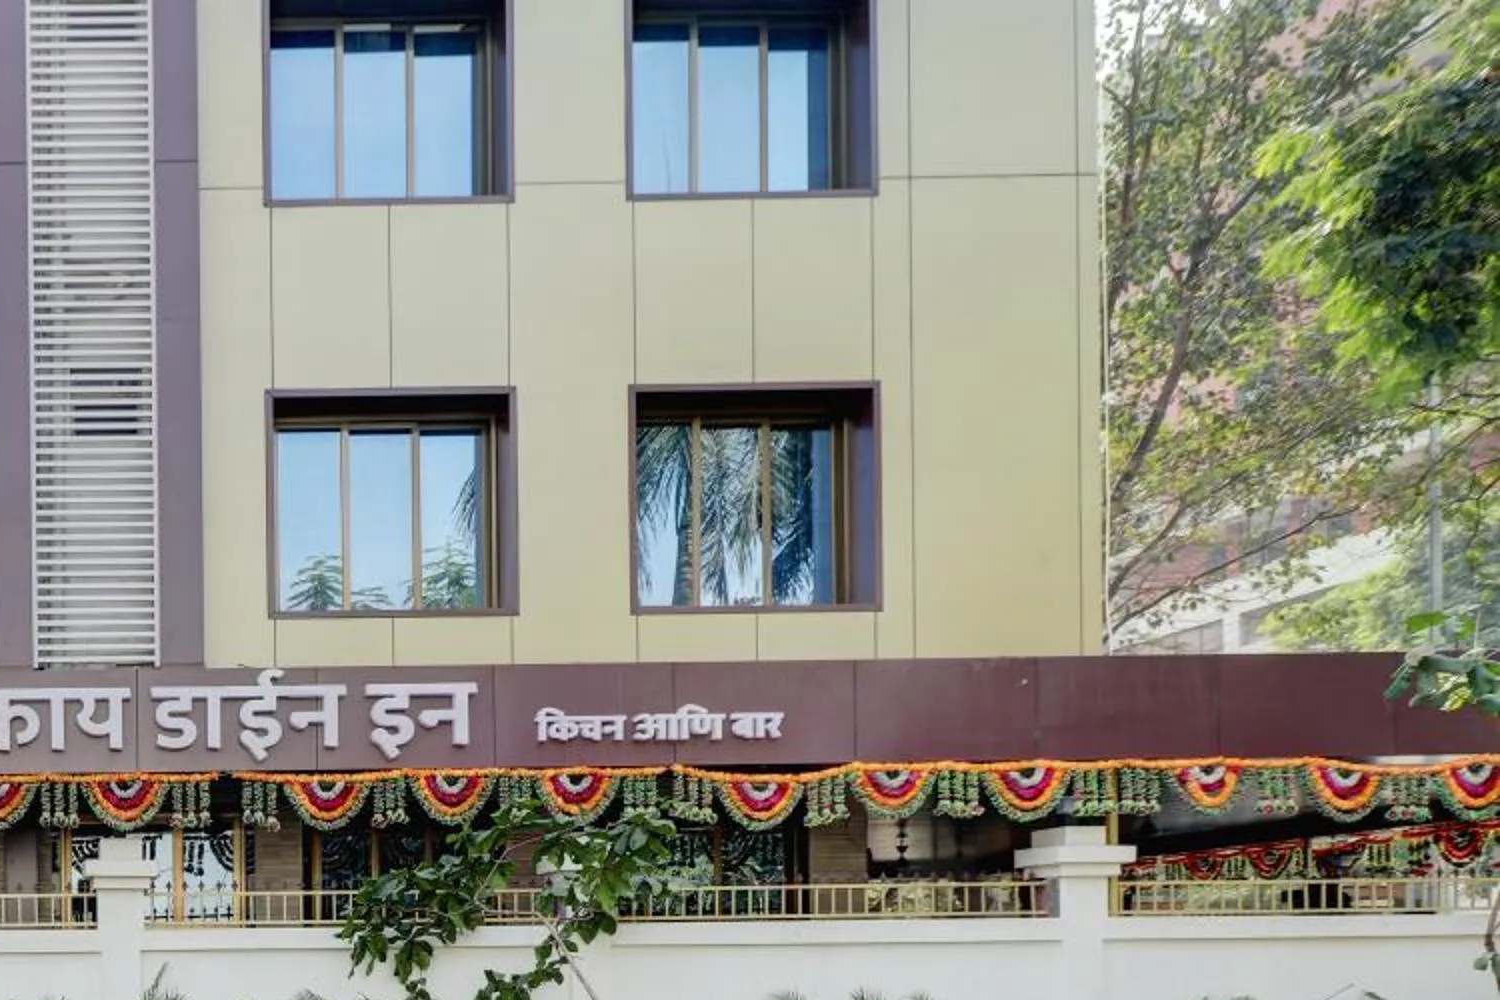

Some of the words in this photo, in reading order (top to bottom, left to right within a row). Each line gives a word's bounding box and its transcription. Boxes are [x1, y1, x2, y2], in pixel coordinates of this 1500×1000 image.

[151, 669, 348, 763] डाईन
[365, 681, 479, 761] इन
[535, 707, 628, 742] किचन
[631, 704, 727, 742] आणि
[730, 711, 785, 740] बार
